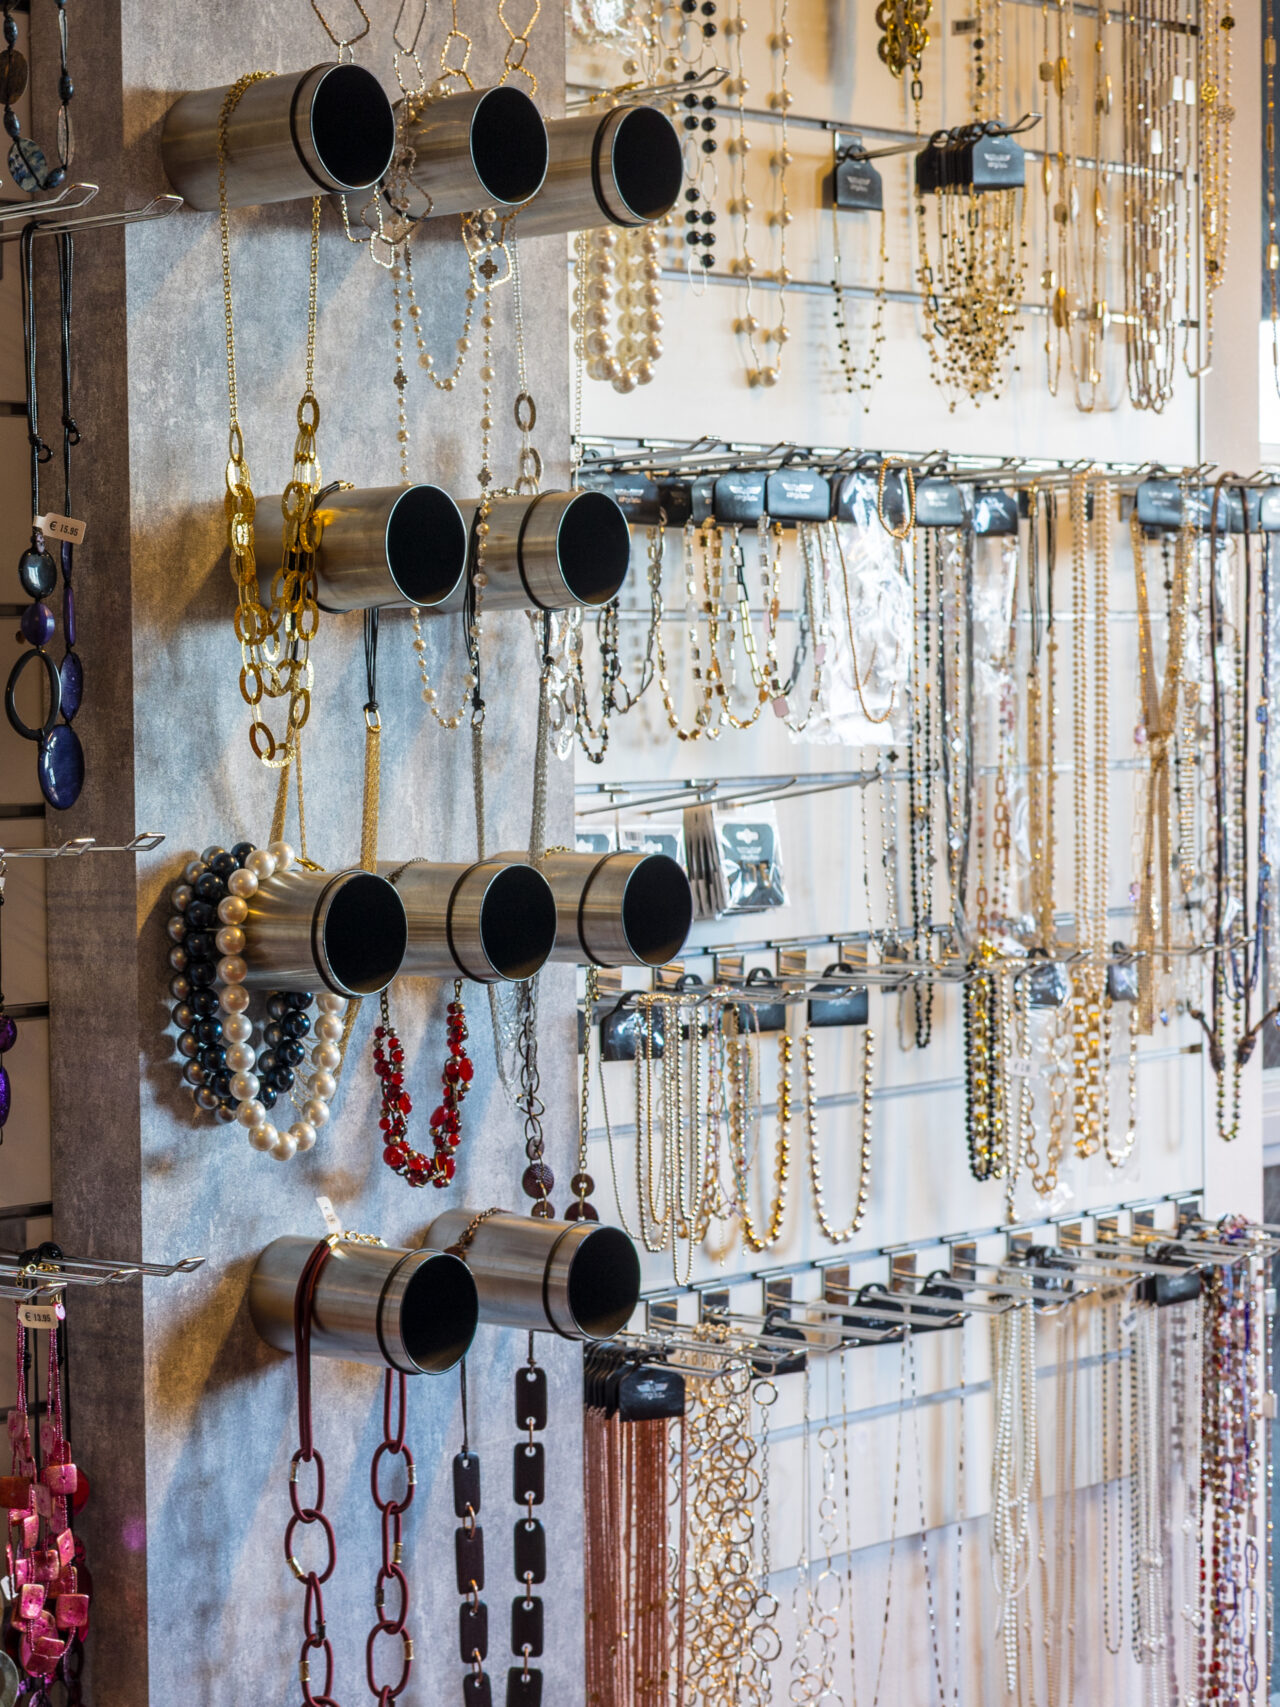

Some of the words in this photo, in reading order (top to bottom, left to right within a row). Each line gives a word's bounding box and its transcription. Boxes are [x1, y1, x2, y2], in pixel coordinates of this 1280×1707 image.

[49, 521, 58, 532] €
[60, 523, 80, 537] 15.95
[24, 1311, 32, 1322] €
